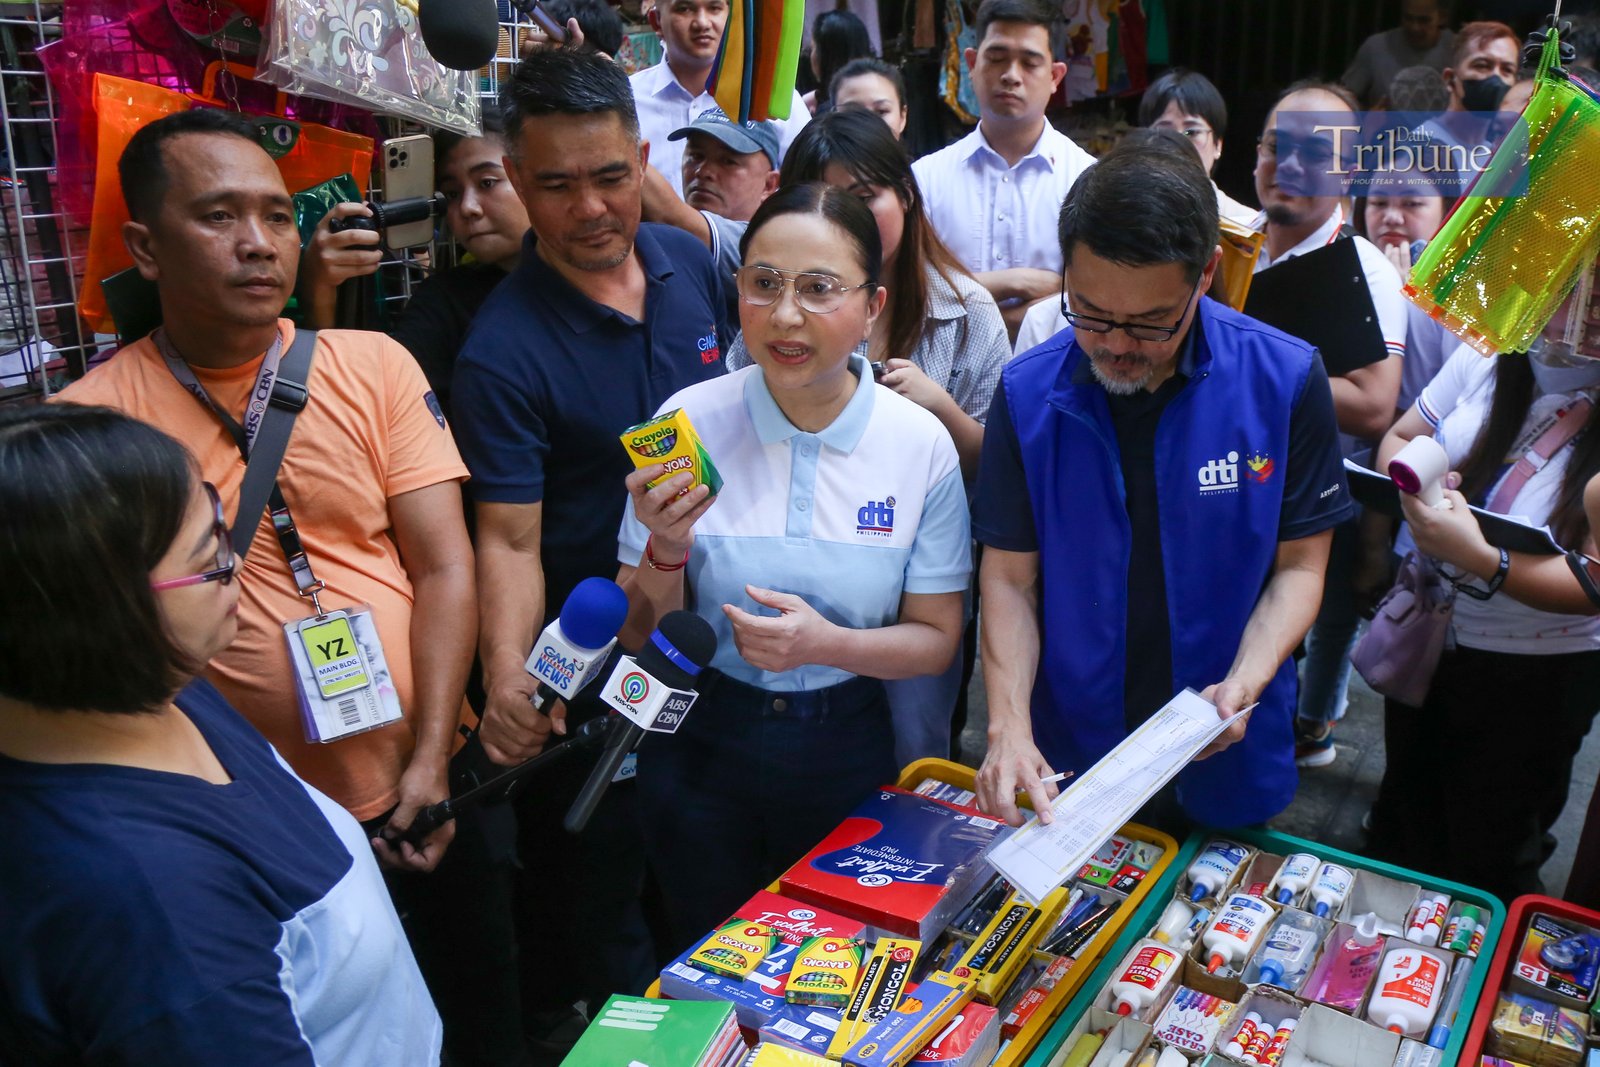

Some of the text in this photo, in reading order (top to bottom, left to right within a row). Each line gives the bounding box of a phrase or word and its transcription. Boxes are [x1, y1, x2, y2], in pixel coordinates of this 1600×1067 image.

[256, 368, 274, 402] CBN
[631, 426, 673, 447] Crayola
[664, 456, 693, 473] YONS
[1198, 451, 1239, 485] dti
[857, 496, 896, 527] dti
[316, 638, 349, 660] YZ
[318, 664, 338, 676] MAIN
[339, 658, 360, 670] BLDG.
[544, 646, 575, 675] GMA
[534, 656, 571, 690] NEWS
[665, 698, 689, 711] ABS
[657, 711, 681, 725] CBN
[851, 845, 916, 865] INTERMEDIATE
[880, 845, 900, 854] PAD
[835, 855, 944, 882] Excellent
[754, 911, 834, 937] Excellent
[980, 911, 1020, 954] MONGOL
[717, 935, 763, 953] CRAYONS
[701, 952, 742, 970] Crayola
[802, 957, 852, 968] CRAYONS
[1128, 969, 1157, 981] WHITE
[1414, 977, 1433, 988] GLUE
[1520, 965, 1546, 982] 15
[797, 981, 843, 990] Crayola
[851, 962, 877, 1013] EBERHARD FABER
[875, 961, 907, 1018] MONGOL
[1406, 979, 1432, 992] WHITE
[1557, 986, 1577, 996] JOY
[876, 1027, 892, 1040] Pencil
[931, 1015, 964, 1048] 1
[1170, 1024, 1204, 1041] CASE
[920, 1049, 942, 1060] ADE
